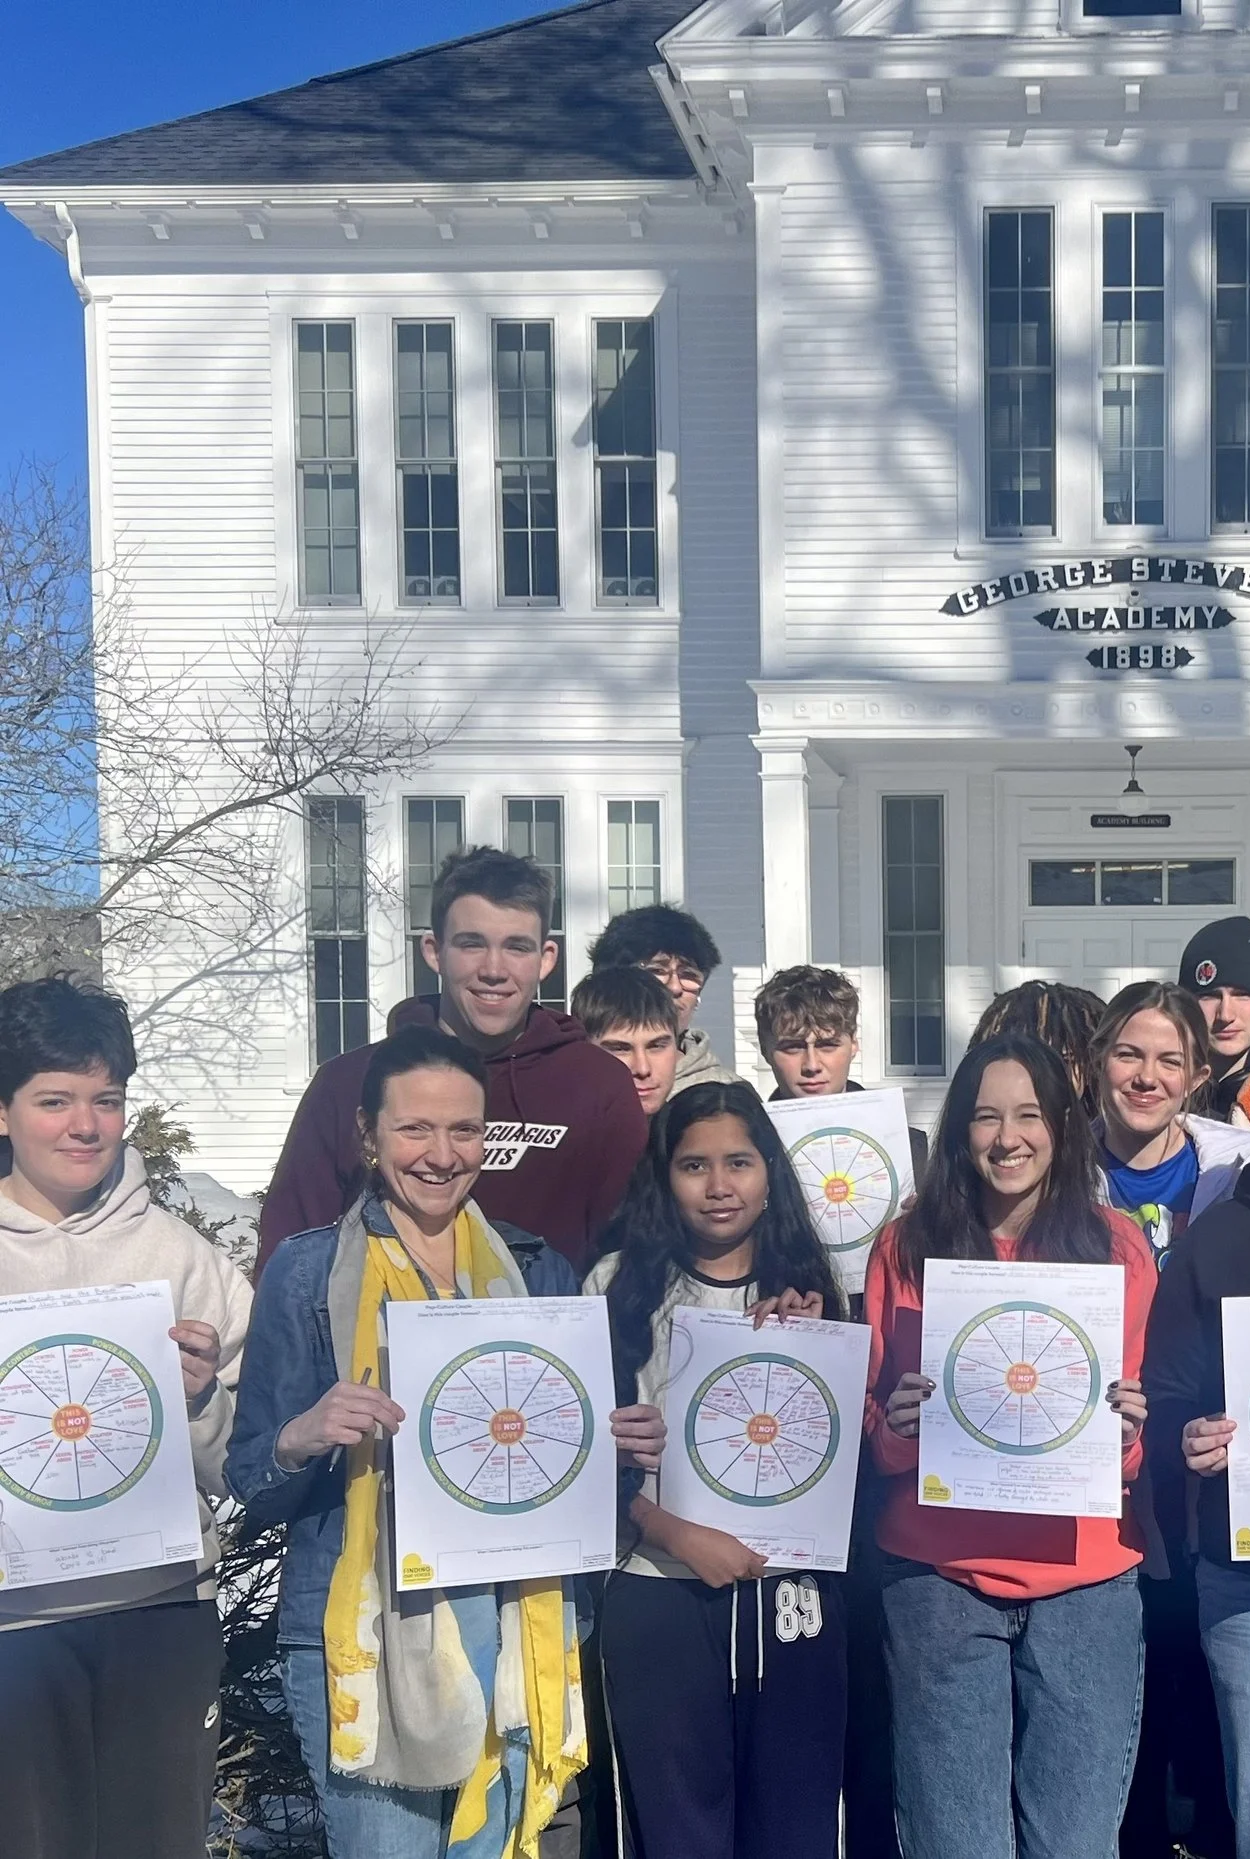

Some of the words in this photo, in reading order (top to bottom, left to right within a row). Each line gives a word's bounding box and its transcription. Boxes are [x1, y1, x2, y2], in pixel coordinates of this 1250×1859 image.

[956, 561, 1112, 614] GEORGE
[1053, 606, 1219, 630] ACADEMY
[1101, 645, 1177, 669] 1898
[485, 1125, 561, 1145] GUAGUS
[60, 1408, 81, 1417] THIS
[56, 1419, 66, 1428] IS
[67, 1417, 87, 1426] NOT
[503, 1422, 521, 1431] NOT
[60, 1427, 84, 1435] LOVE
[497, 1432, 517, 1440] LOVE
[403, 1566, 431, 1574] FINDING
[775, 1574, 823, 1643] 89
